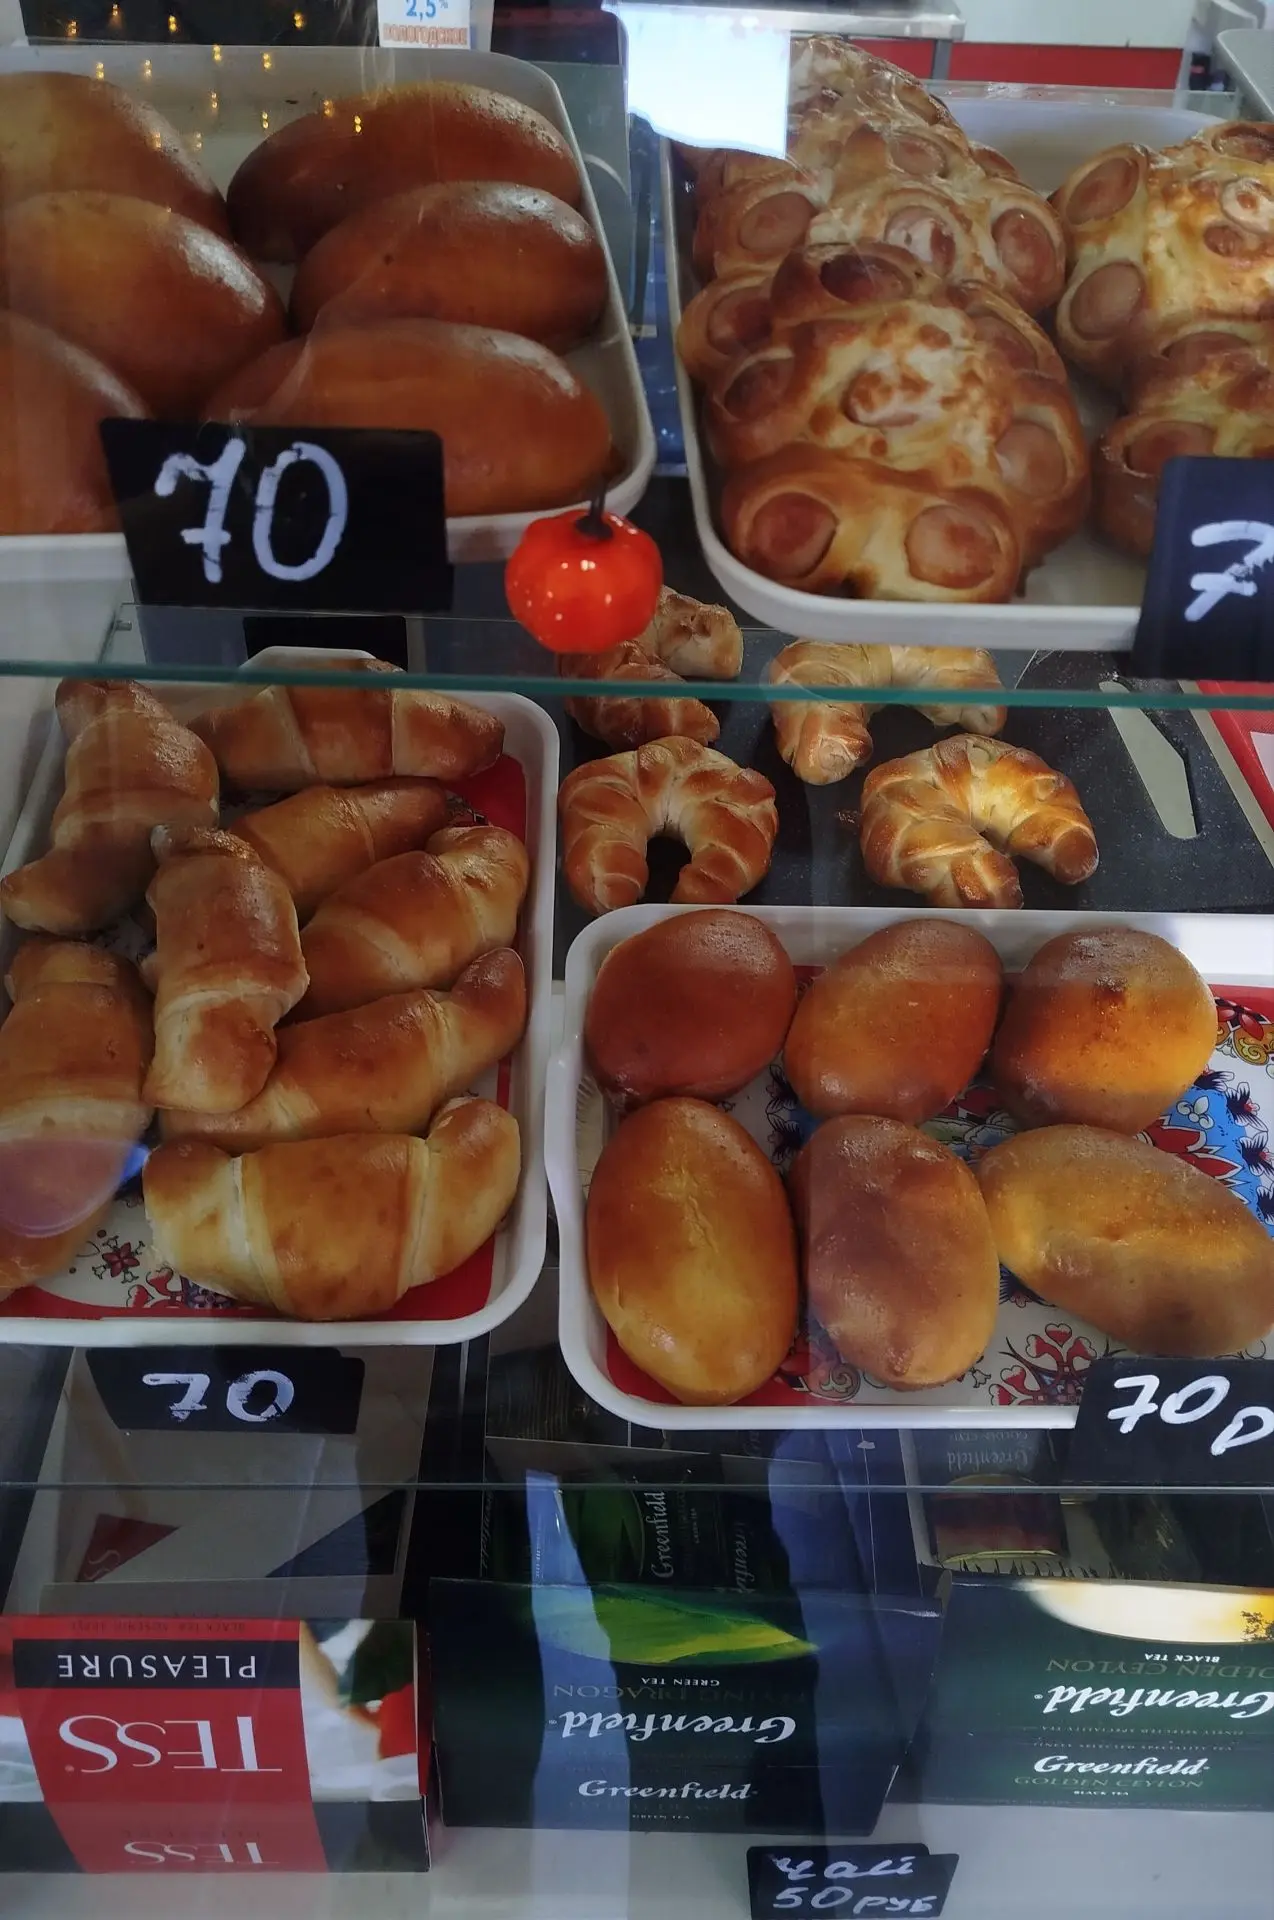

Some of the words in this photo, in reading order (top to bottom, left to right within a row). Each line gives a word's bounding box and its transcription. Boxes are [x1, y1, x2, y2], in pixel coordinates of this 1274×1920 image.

[155, 438, 348, 583] 70
[1184, 520, 1274, 621] 7
[142, 1369, 294, 1421] 70
[1107, 1374, 1230, 1434] 70
[644, 1490, 675, 1579] Greenfield
[57, 1655, 256, 1678] PLEASURE
[1045, 1658, 1168, 1675] CEYLON
[1145, 1653, 1169, 1662] TEA
[1174, 1654, 1221, 1663] BLACK
[641, 1677, 665, 1685] TEA
[674, 1678, 720, 1686] GREEN
[1043, 1685, 1274, 1719] Greenfield
[559, 1711, 796, 1743] Greenfield
[59, 1715, 283, 1773] TESS
[1034, 1755, 1209, 1775] Greenfield
[578, 1779, 752, 1800] Greenfield
[1014, 1776, 1109, 1787] GOLDEN
[1116, 1778, 1204, 1788] CEYLON
[124, 1841, 280, 1864] TESS
